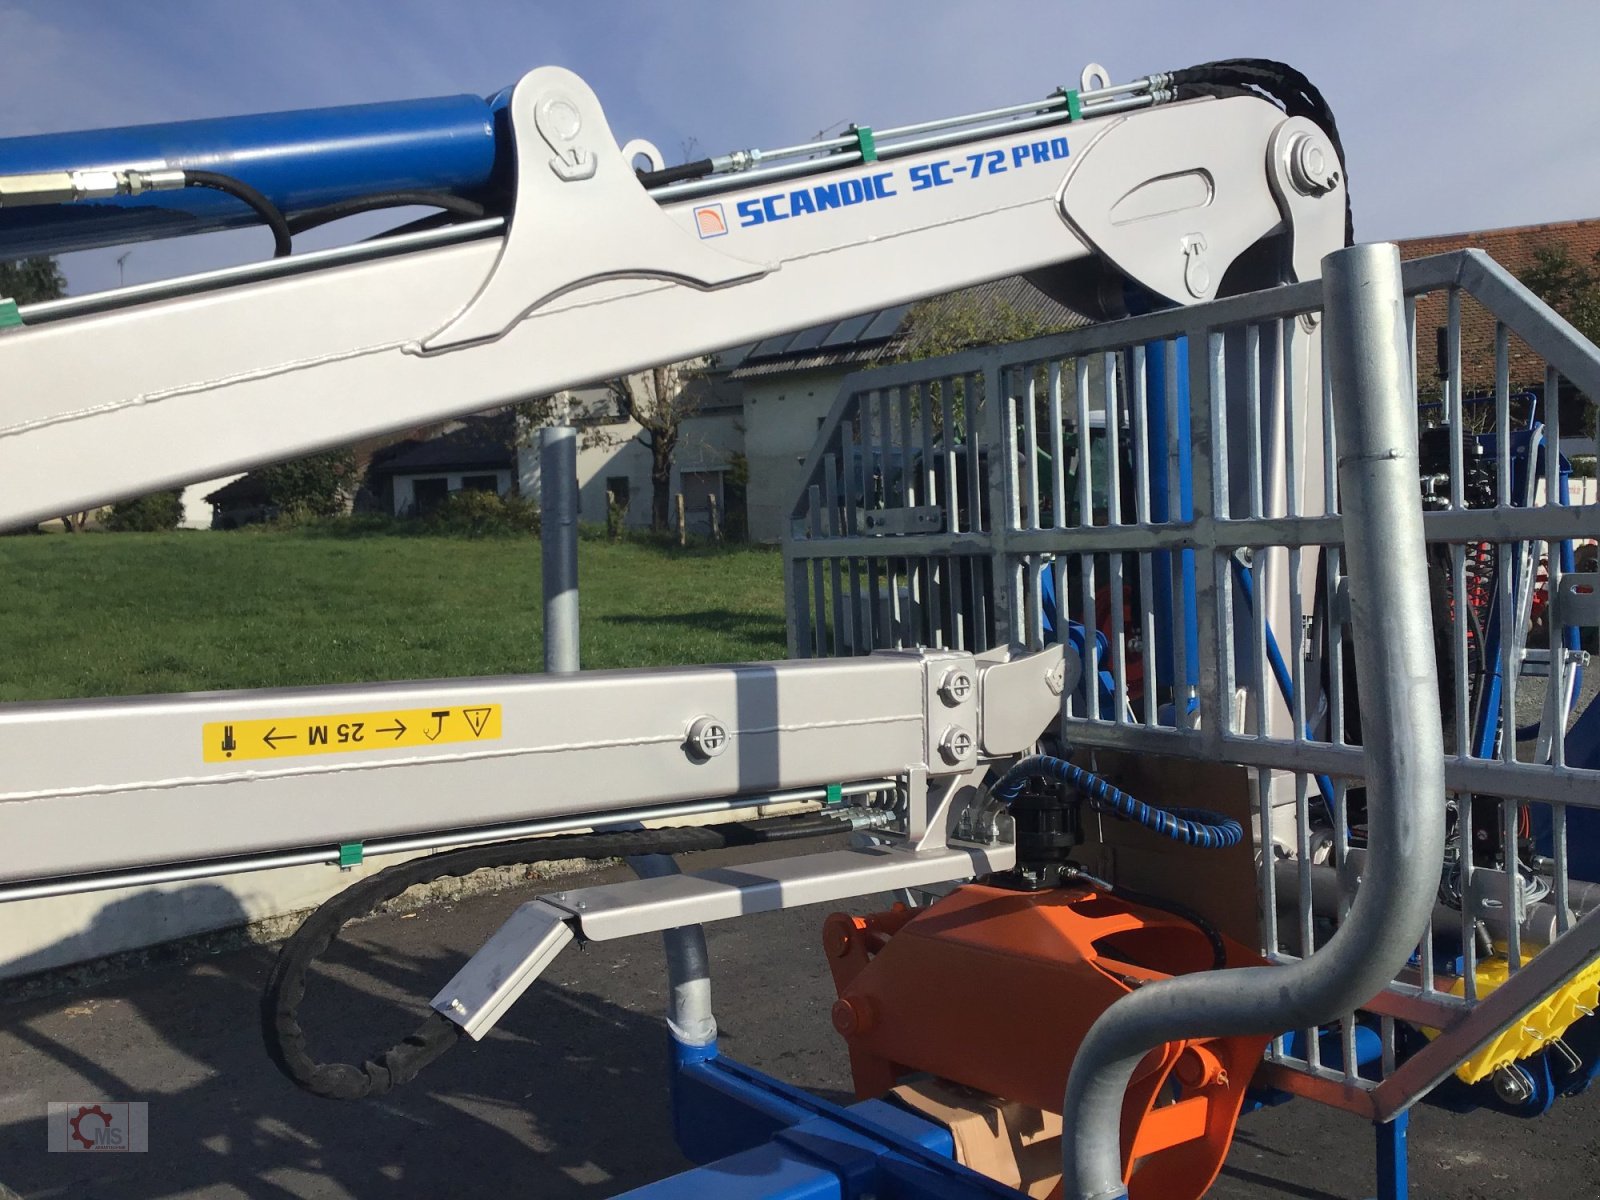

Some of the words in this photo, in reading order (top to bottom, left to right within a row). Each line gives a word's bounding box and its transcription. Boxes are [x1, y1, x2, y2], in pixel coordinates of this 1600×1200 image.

[736, 172, 897, 227] SCANDIC
[909, 151, 1007, 191] SC-72
[1012, 137, 1070, 168] PRO
[308, 726, 328, 746] M
[336, 722, 365, 743] 25
